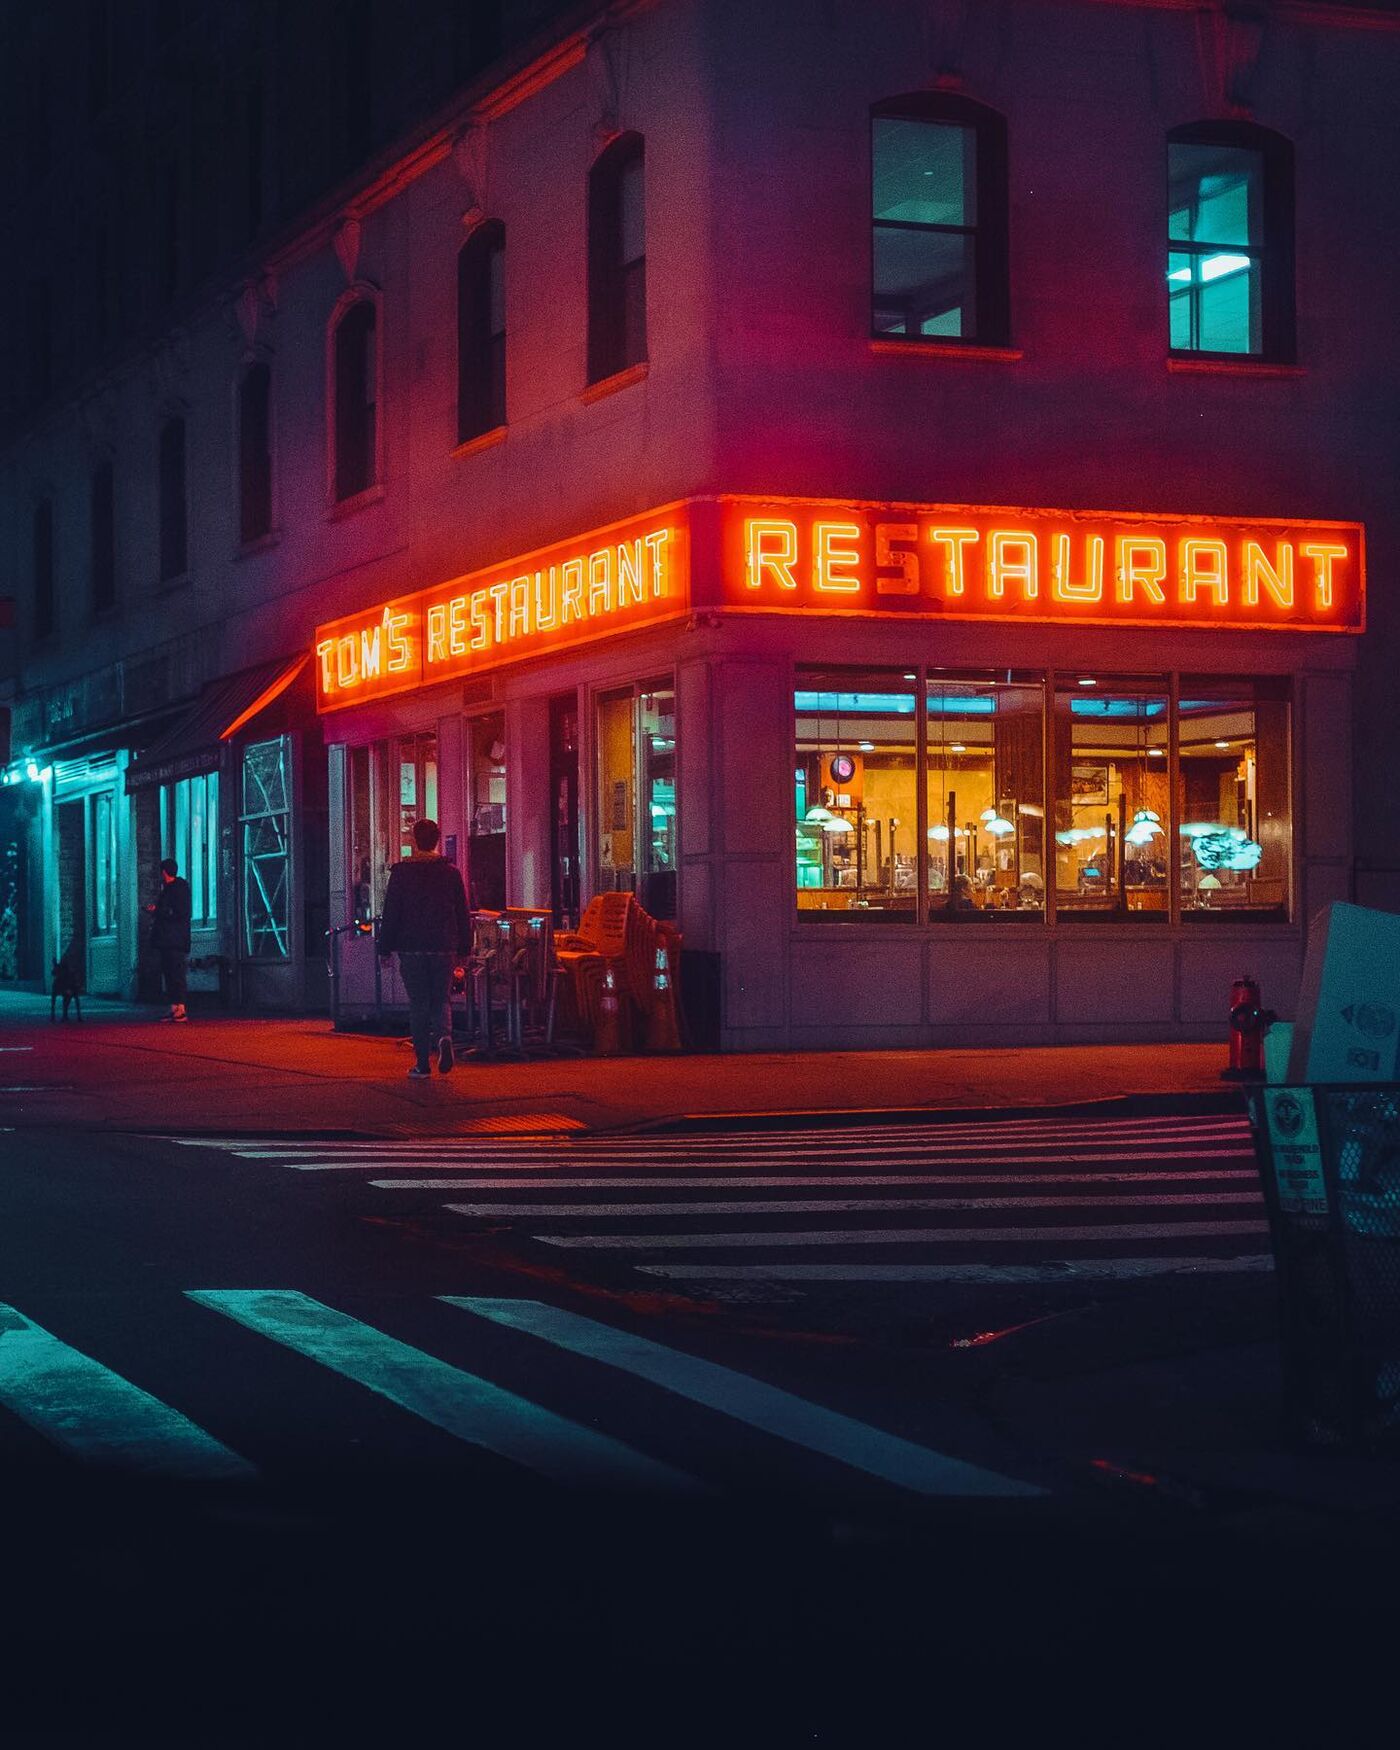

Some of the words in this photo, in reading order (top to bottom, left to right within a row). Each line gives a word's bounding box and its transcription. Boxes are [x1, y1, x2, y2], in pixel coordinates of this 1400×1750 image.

[316, 605, 412, 694] TOM'S
[426, 528, 674, 663] RESTAURANT
[745, 518, 1348, 608] RESTAURANT
